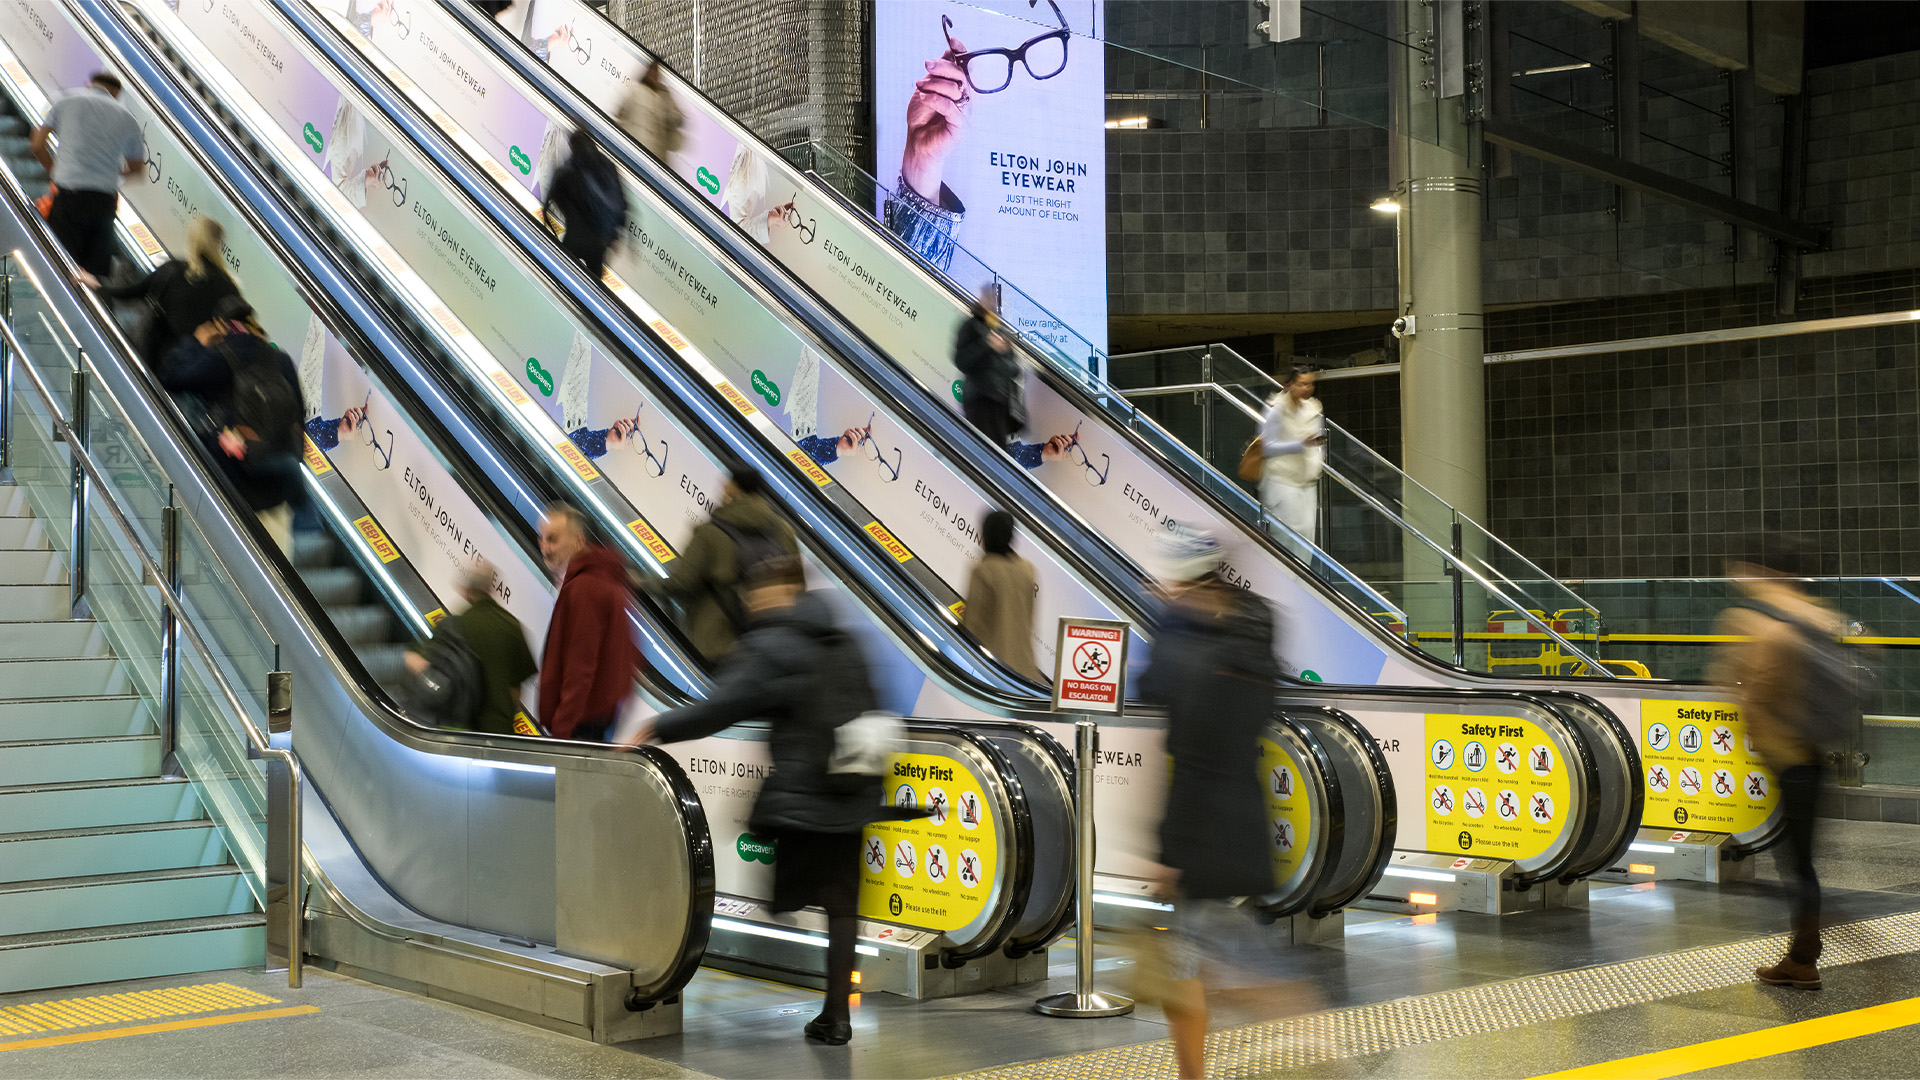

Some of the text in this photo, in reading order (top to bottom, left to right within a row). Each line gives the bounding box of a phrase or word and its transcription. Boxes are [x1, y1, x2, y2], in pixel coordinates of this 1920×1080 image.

[29, 8, 54, 43] EYEWEAR
[222, 4, 284, 74] ELTON JOHN EYEWEAR
[420, 32, 438, 54] ELTON
[439, 50, 456, 70] JOHN
[456, 66, 486, 98] EYEWEAR
[600, 58, 622, 79] ELTON
[990, 152, 1087, 176] ELTON JOHN
[167, 176, 188, 208] ELTON
[698, 168, 719, 191] Specsavers
[1002, 172, 1075, 193] EYEWEAR
[998, 206, 1079, 222] AMOUNT OF ELTON
[1006, 194, 1072, 209] JUST THE RIGHT
[132, 226, 158, 252] KEEP LEFT
[414, 201, 496, 292] ELTON JOHN EYEWEAR
[628, 221, 718, 309] ELTON JOHN EYEWEAR
[604, 276, 621, 288] LEFT
[824, 239, 918, 322] ELTON JOHN EYEWEAR
[654, 322, 685, 348] KEEP LEFT
[1018, 317, 1062, 330] New range
[1060, 334, 1068, 343] at
[493, 372, 512, 390] KEEP
[506, 387, 526, 402] LEFT
[528, 362, 552, 392] Specsavers
[753, 374, 778, 402] Specsavers
[719, 384, 752, 412] KEEP LEFT
[307, 452, 326, 470] LEFT
[560, 444, 594, 477] KEEP LEFT
[791, 452, 827, 483] KEEP LEFT
[680, 474, 714, 514] ELTON
[685, 507, 698, 522] JUST
[915, 480, 982, 546] ELTON JOHN
[1128, 512, 1156, 537] JUST THE
[358, 520, 395, 558] KEEP LEFT
[404, 467, 511, 604] ELTON JOHN EYEEAR
[408, 502, 420, 518] JUST
[420, 516, 430, 532] THE
[430, 528, 446, 551] RIGHT
[920, 511, 964, 552] JUST THE RIGHT
[1124, 483, 1252, 591] ELTON WEAR
[632, 522, 670, 558] KEEP LEFT
[868, 525, 908, 560] KEEP LEFT
[1072, 628, 1118, 640] WARNING!
[1068, 692, 1108, 702] ESCALATOR
[1678, 708, 1738, 722] Safety First
[1462, 724, 1524, 738] Safety First
[690, 758, 726, 776] ELTON
[731, 762, 764, 780] JOHN
[1096, 750, 1142, 767] EWEAR
[894, 762, 953, 781] Safety First
[1095, 774, 1129, 786] OF ELTON
[702, 785, 716, 795] JUST
[718, 786, 730, 797] THE
[732, 788, 751, 798] RIGHT
[1692, 814, 1707, 822] Please
[740, 842, 775, 856] Specsavers
[906, 902, 920, 912] Please
